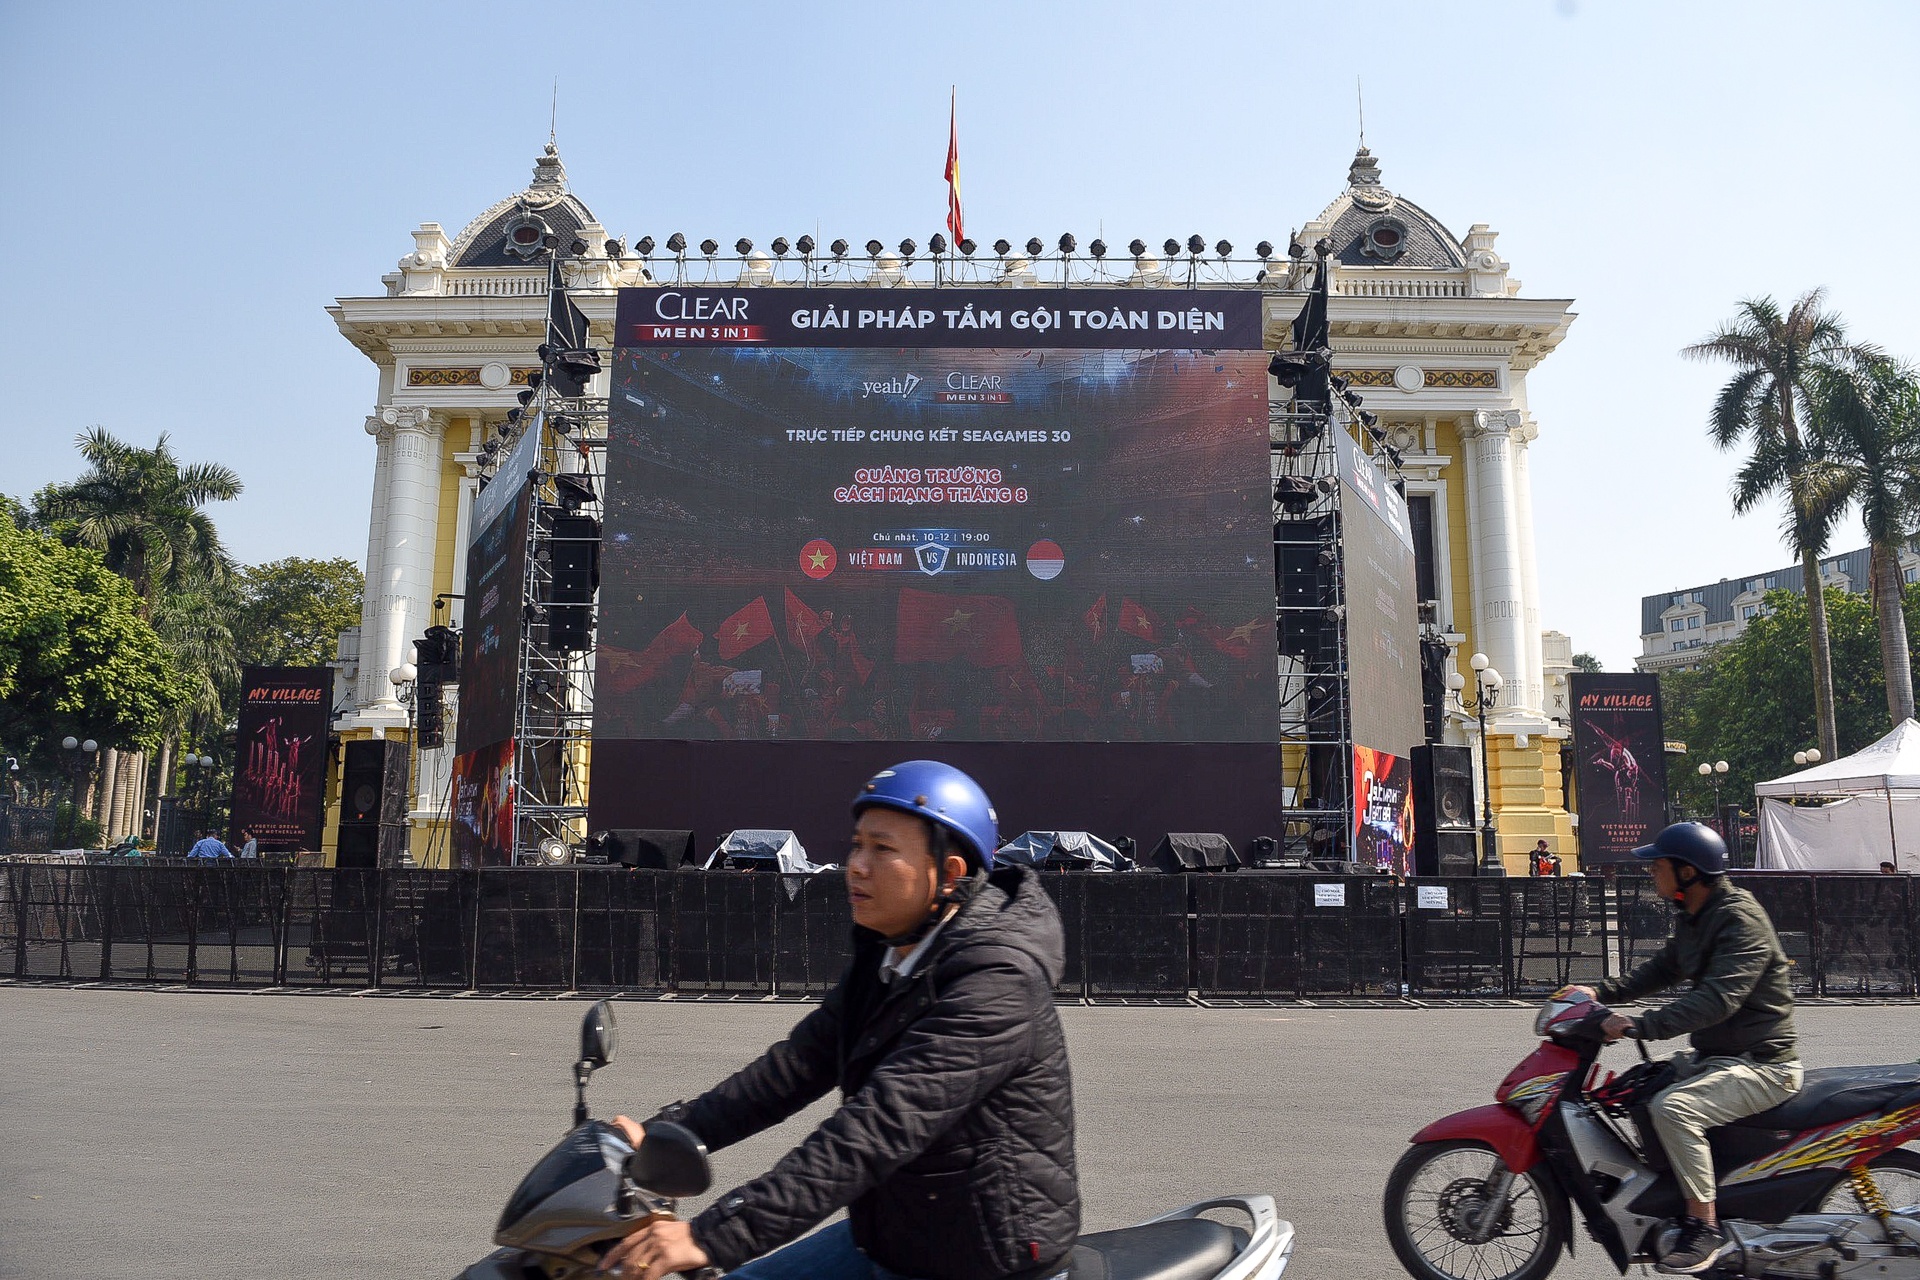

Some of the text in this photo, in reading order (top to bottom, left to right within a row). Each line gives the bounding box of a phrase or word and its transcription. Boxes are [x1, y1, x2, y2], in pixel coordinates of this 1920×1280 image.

[655, 292, 749, 320] CLEAR
[791, 303, 1224, 334] GIẢI PHÁP TẮM GỘI TOÀN DIỆN
[653, 327, 749, 338] MEN 3 IN 1
[946, 372, 1001, 390] CLEAR
[946, 393, 977, 401] MEN
[786, 427, 1071, 444] TRỰC TIẾP CHUNG KẾT SEAGAMES 30
[855, 465, 1002, 484] QUẢNG TRƯỜNG
[834, 485, 1028, 505] CÁCH MẠNG THÁNG 8
[924, 532, 949, 541] 10-12
[962, 533, 990, 541] 19:00
[849, 550, 1017, 568] VIỆT NAM VS INDONESIA
[248, 687, 322, 701] MY VILLAGE
[1580, 694, 1652, 707] MY VILLAGE
